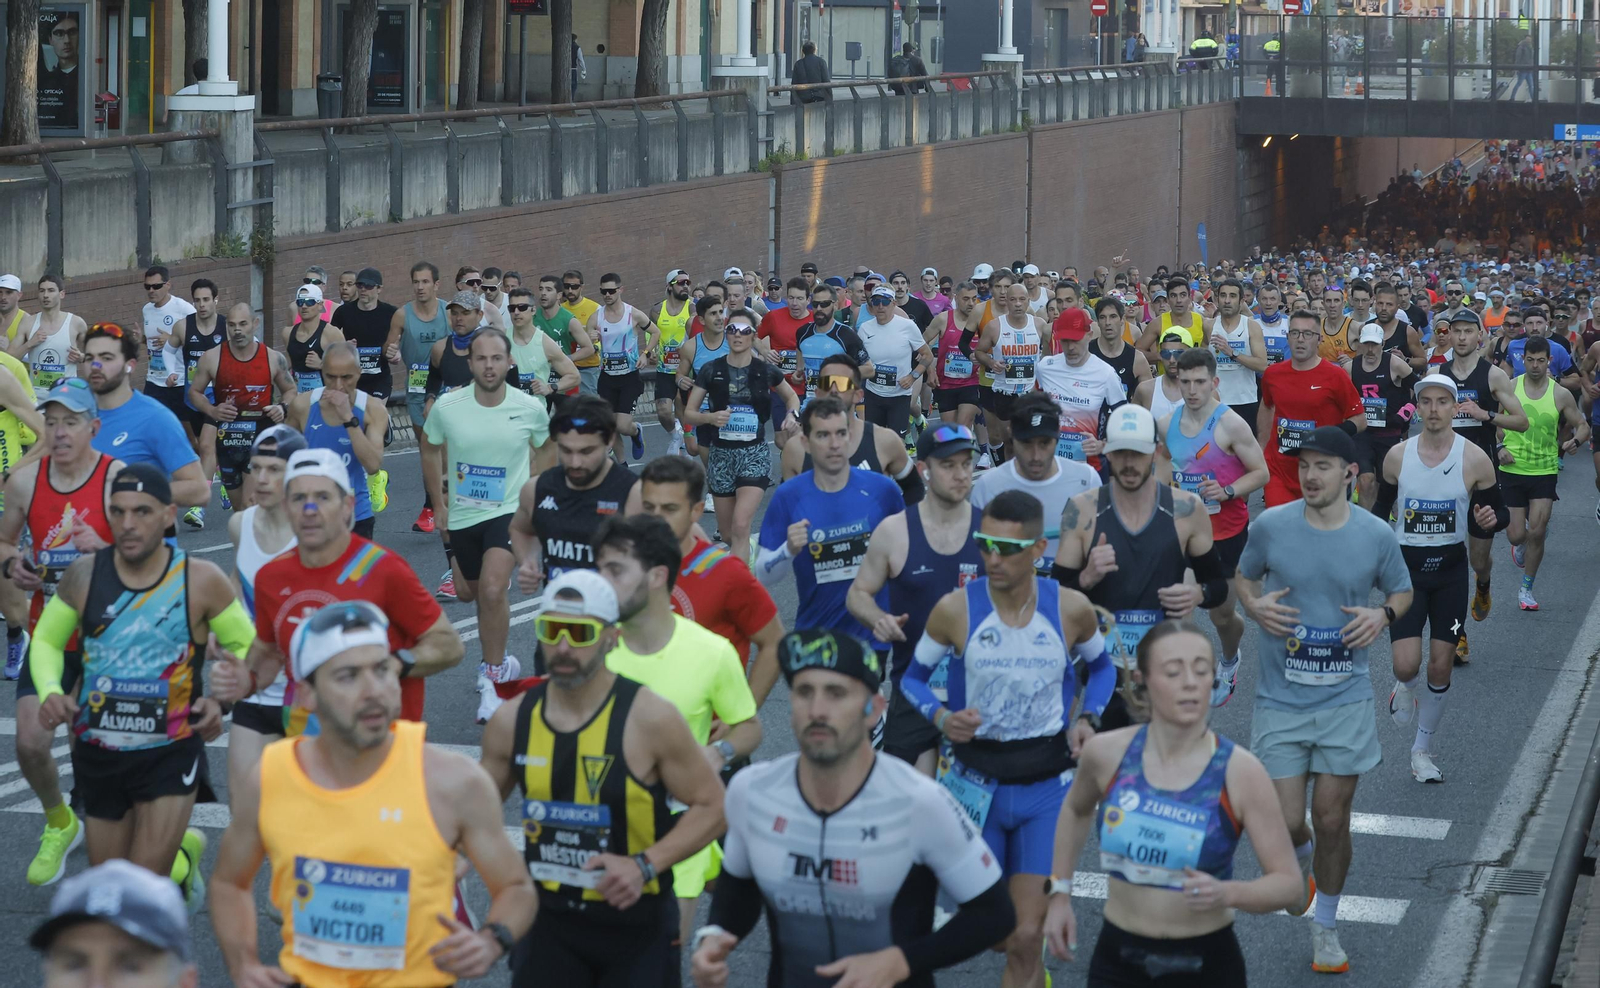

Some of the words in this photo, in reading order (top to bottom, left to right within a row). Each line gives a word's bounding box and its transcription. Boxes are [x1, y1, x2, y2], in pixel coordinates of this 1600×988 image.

[1001, 344, 1038, 356] MADRID
[948, 366, 967, 374] DANIEL
[230, 422, 252, 430] ZURICH
[1288, 420, 1311, 428] ZURICH
[1059, 433, 1083, 441] ZURICH
[1288, 431, 1301, 439] 3703
[223, 437, 252, 447] GARZÓN
[471, 467, 501, 476] ZURICH
[468, 488, 489, 500] JAVI
[1422, 502, 1450, 511] ZURICH
[1422, 514, 1438, 523] 3357
[828, 523, 864, 539] ZURICH
[1413, 522, 1446, 534] JULIEN
[813, 557, 844, 571] MARCO
[1119, 613, 1157, 624] ZURICH
[1121, 630, 1140, 641] 7275
[1307, 647, 1332, 657] 13094
[1285, 657, 1320, 672] OWAIN
[1322, 660, 1354, 672] LAVIS
[115, 682, 160, 695] ZURICH
[99, 710, 156, 733] ÁLVARO
[549, 805, 600, 823] ZURICH
[1142, 799, 1198, 825] ZURICH
[1126, 842, 1169, 866] LORI
[330, 866, 398, 888] ZURICH
[309, 915, 385, 944] VICTOR
